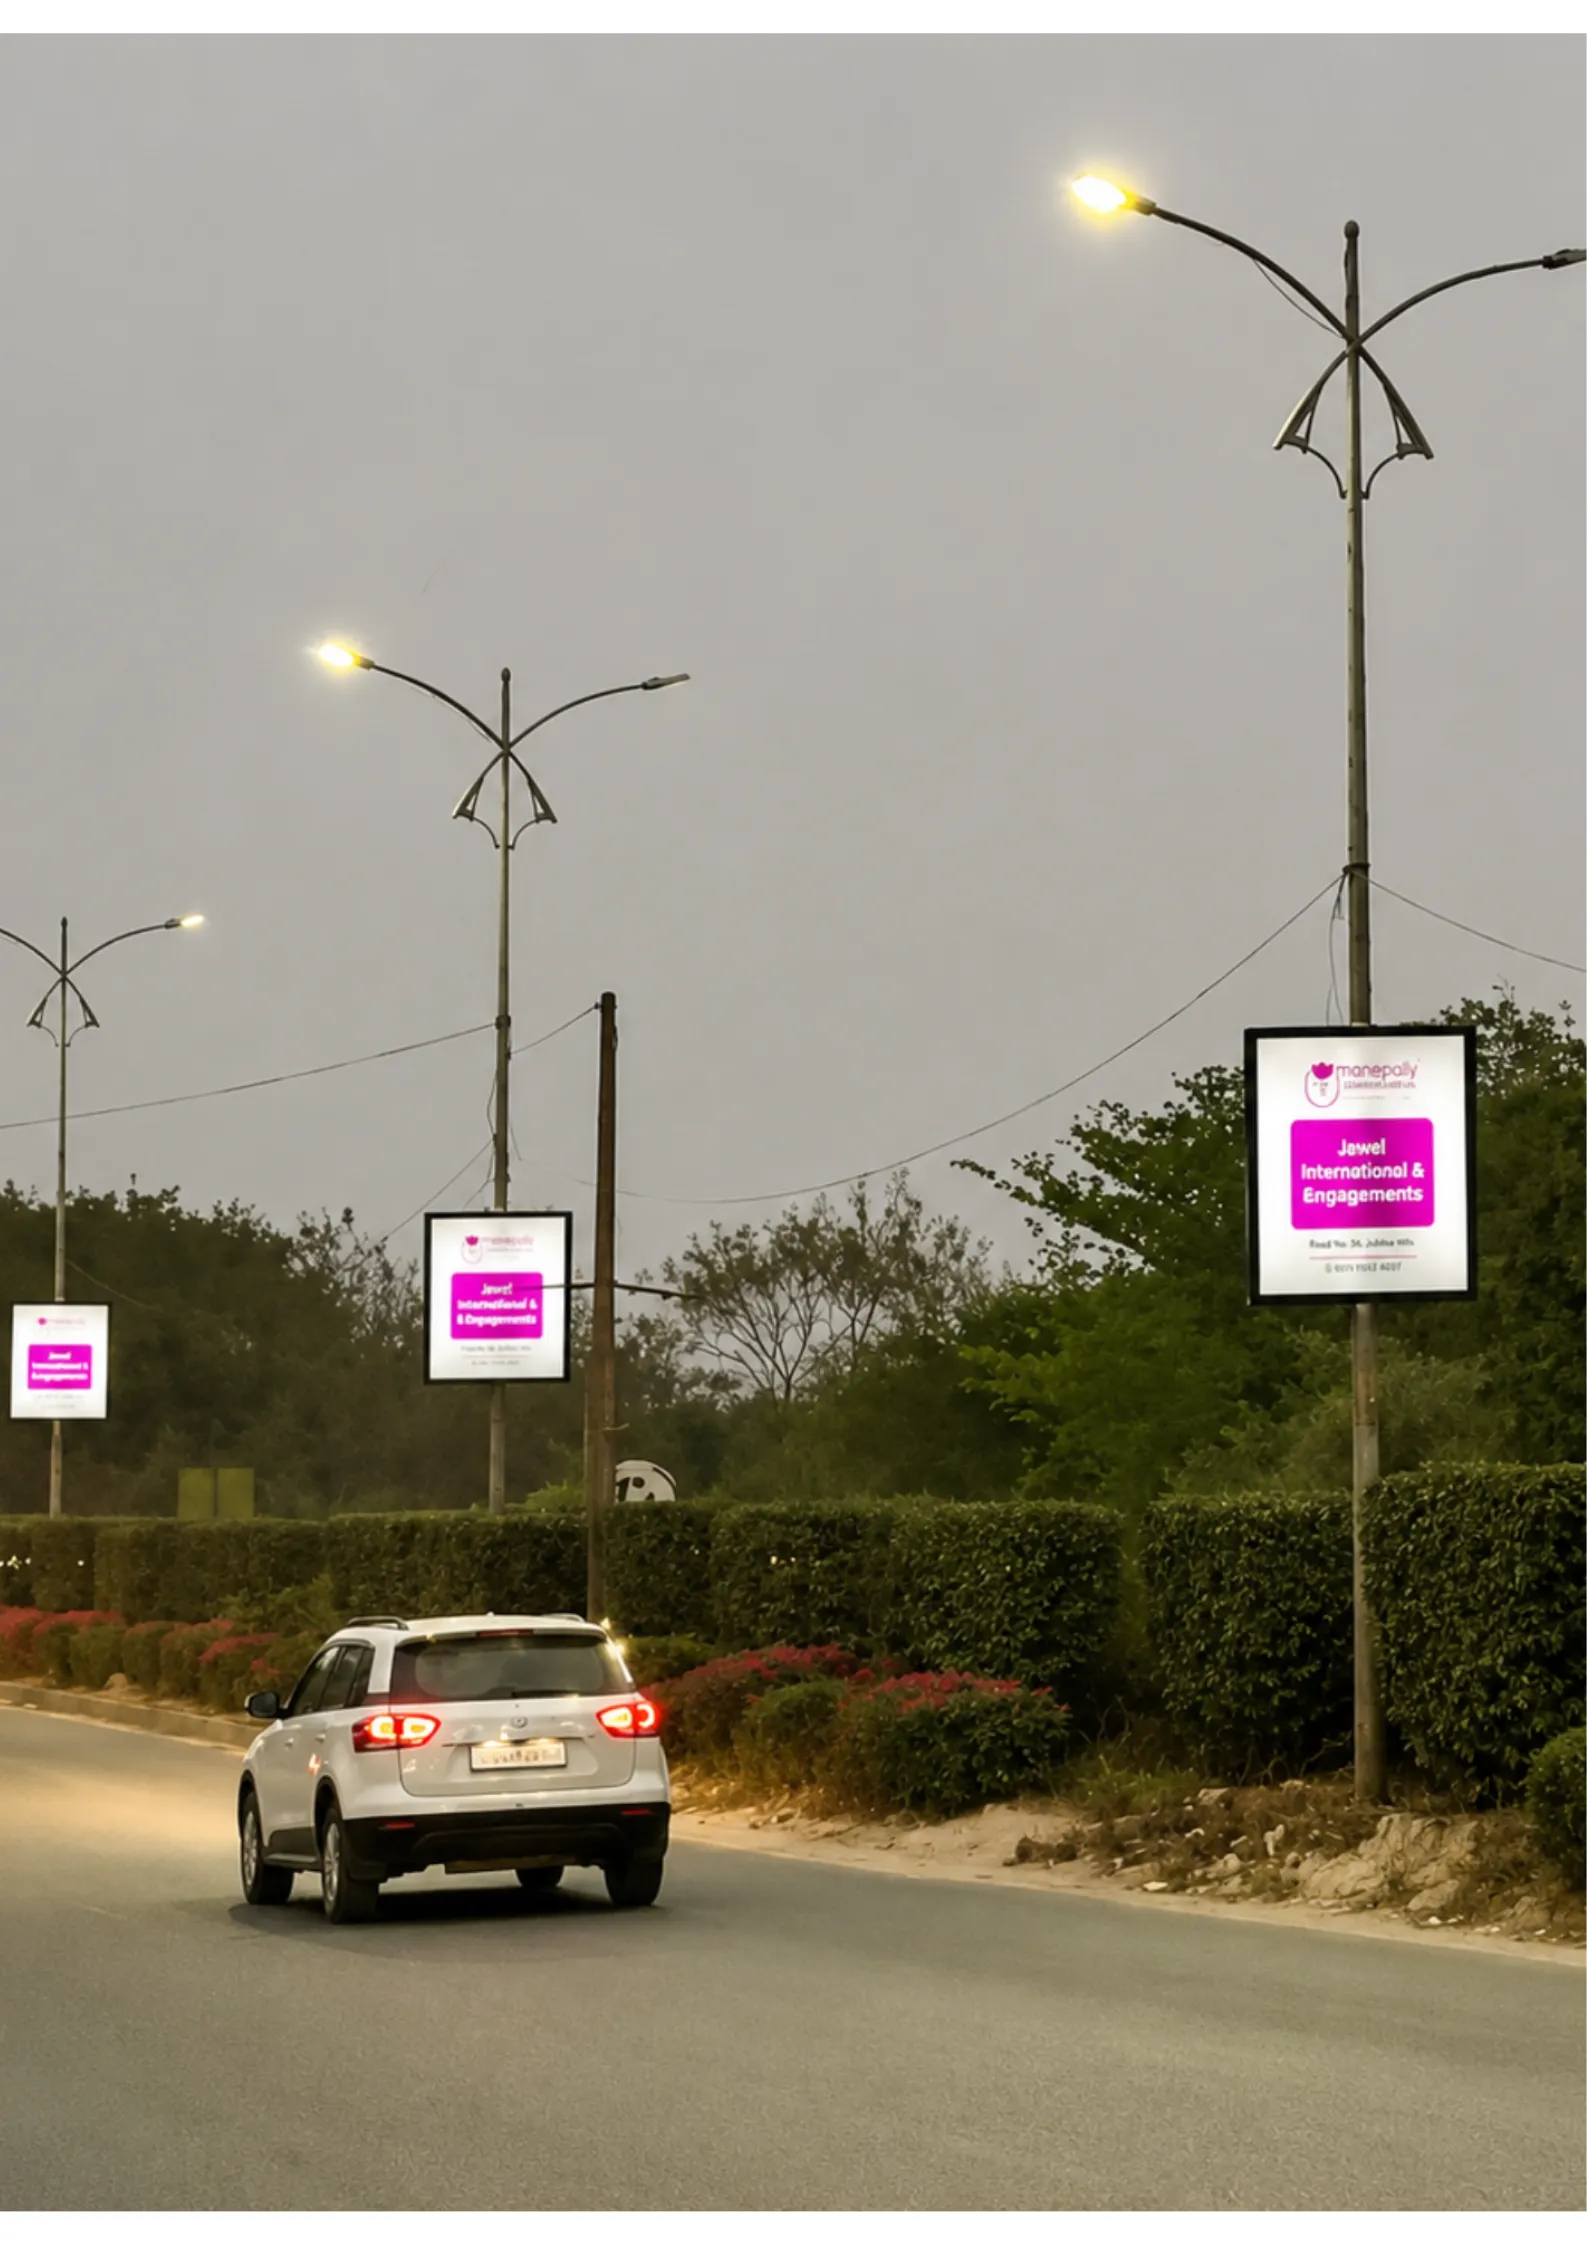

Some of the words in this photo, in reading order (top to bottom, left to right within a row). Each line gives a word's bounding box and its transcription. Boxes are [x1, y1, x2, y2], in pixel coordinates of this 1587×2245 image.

[1301, 1161, 1407, 1180] International
[1411, 1161, 1425, 1179] &
[1302, 1185, 1424, 1208] Engagements
